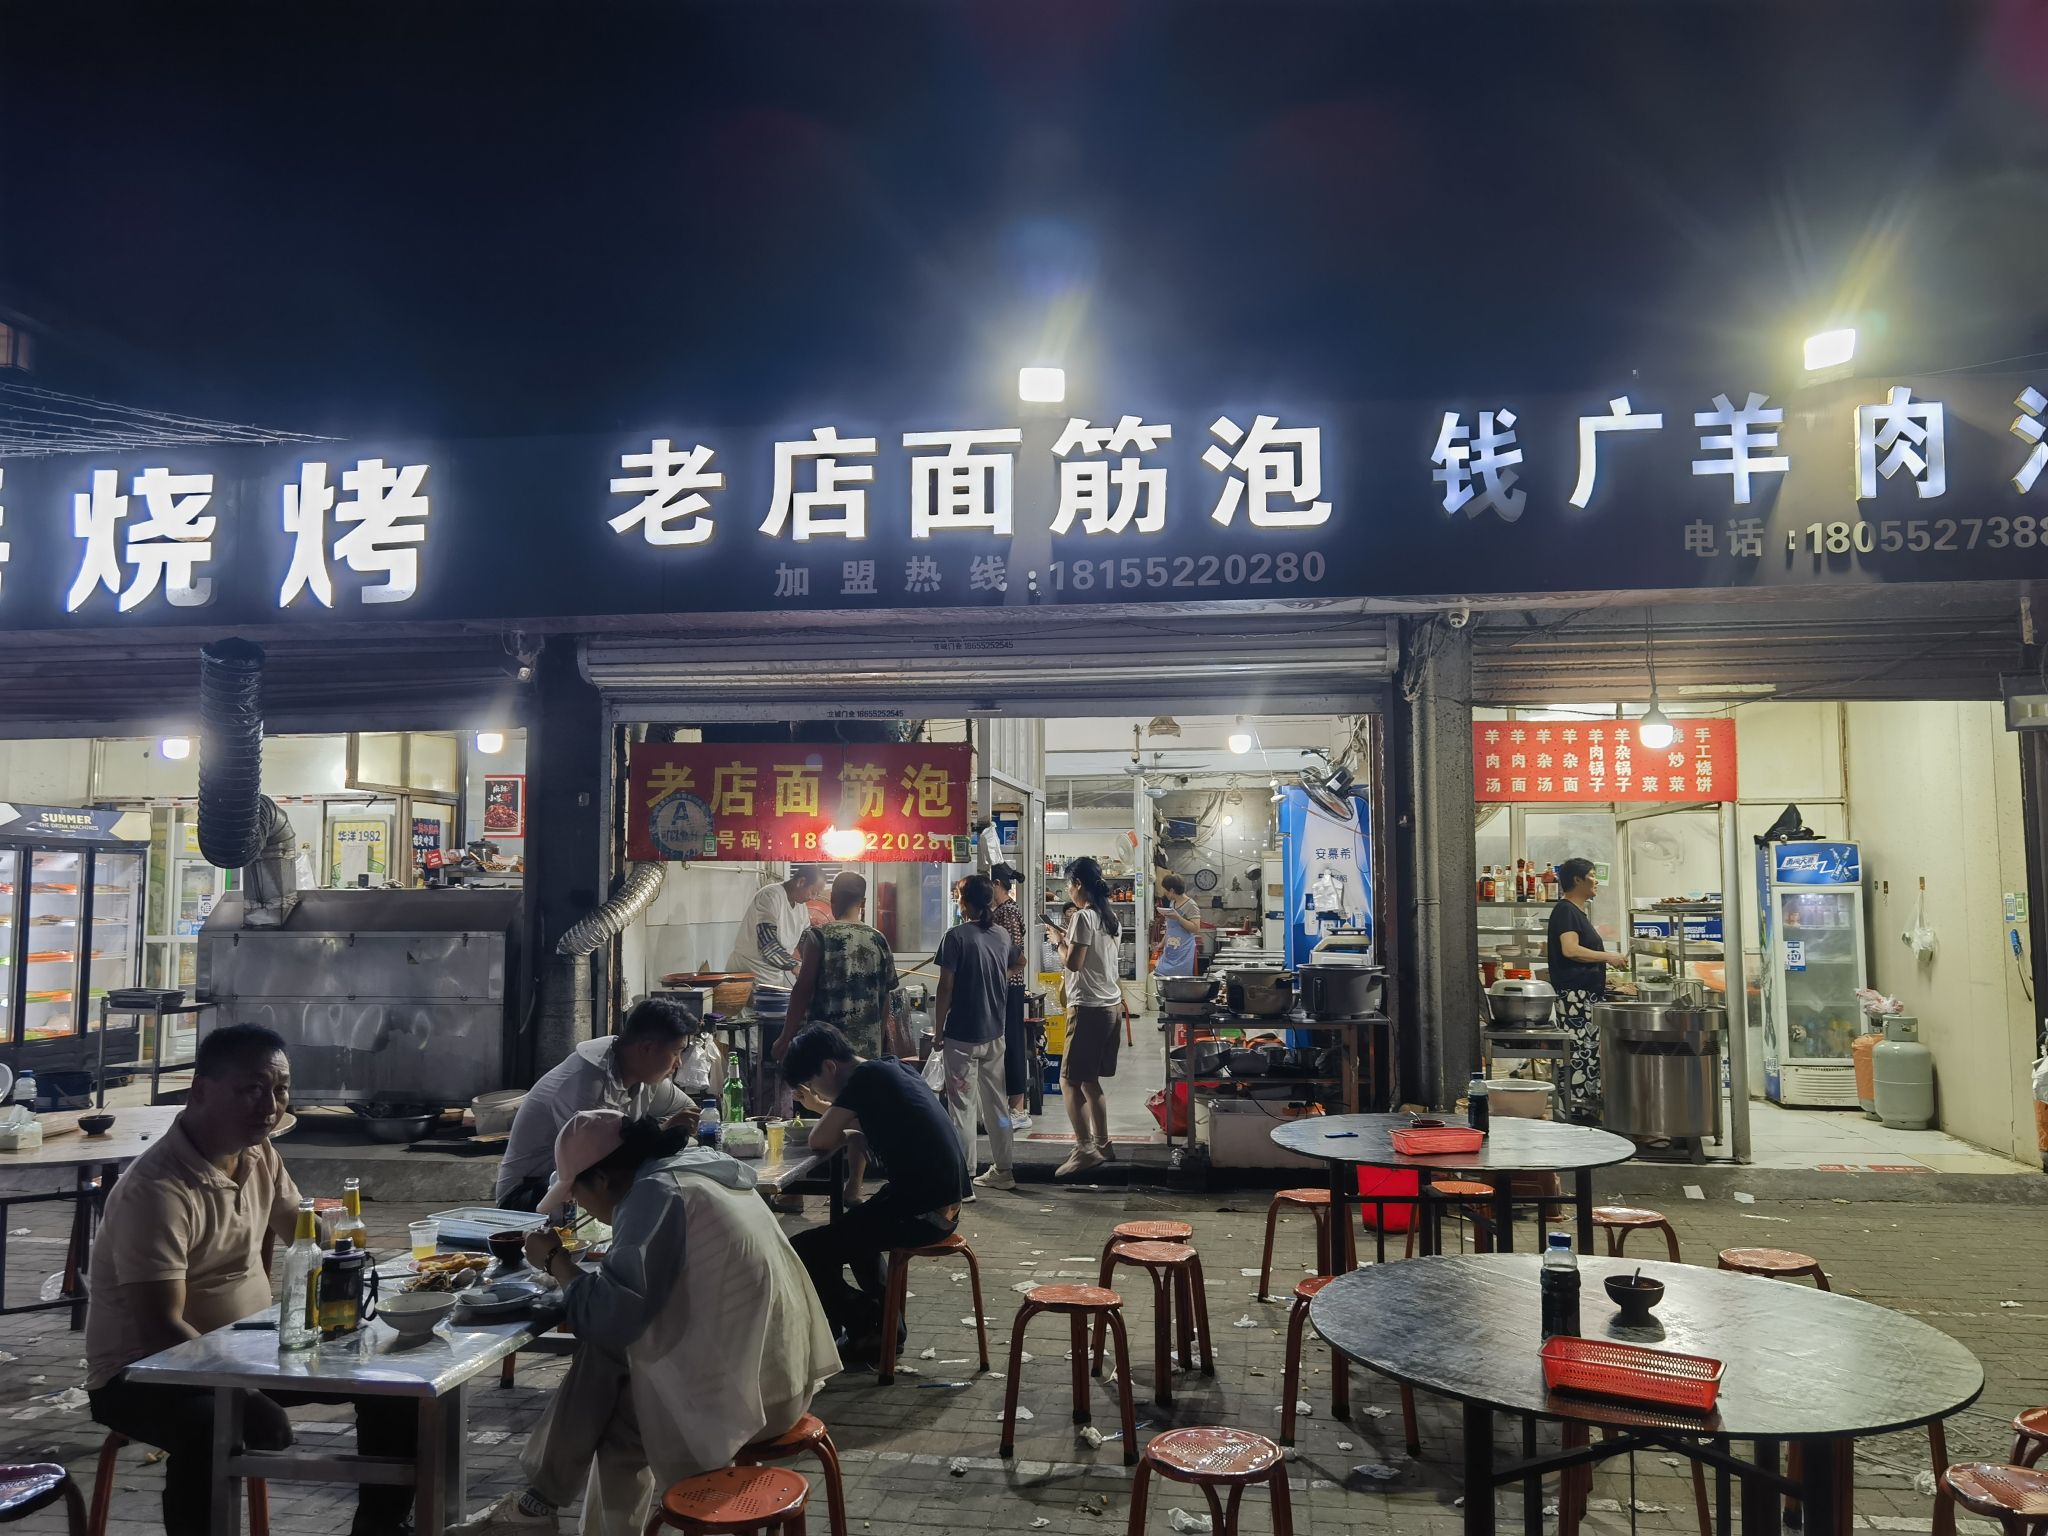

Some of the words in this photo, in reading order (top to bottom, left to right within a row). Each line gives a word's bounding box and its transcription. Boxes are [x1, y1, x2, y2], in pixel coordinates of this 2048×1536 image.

[609, 415, 1333, 547] 老店面筋泡
[0, 458, 430, 613] 烧烤
[646, 761, 952, 818] 老店面筋泡
[1484, 729, 1501, 792] 羊肉汤
[1510, 729, 1526, 792] 羊肉面
[1536, 729, 1552, 792] 羊杂汤
[1562, 729, 1578, 792] 羊杂面
[1588, 728, 1605, 792] 羊肉锅子
[1614, 728, 1632, 792] 羊杂锅子
[1694, 727, 1712, 792] 手工烧饼
[41, 813, 92, 825] SUMMER
[1316, 847, 1351, 860] 安慕希
